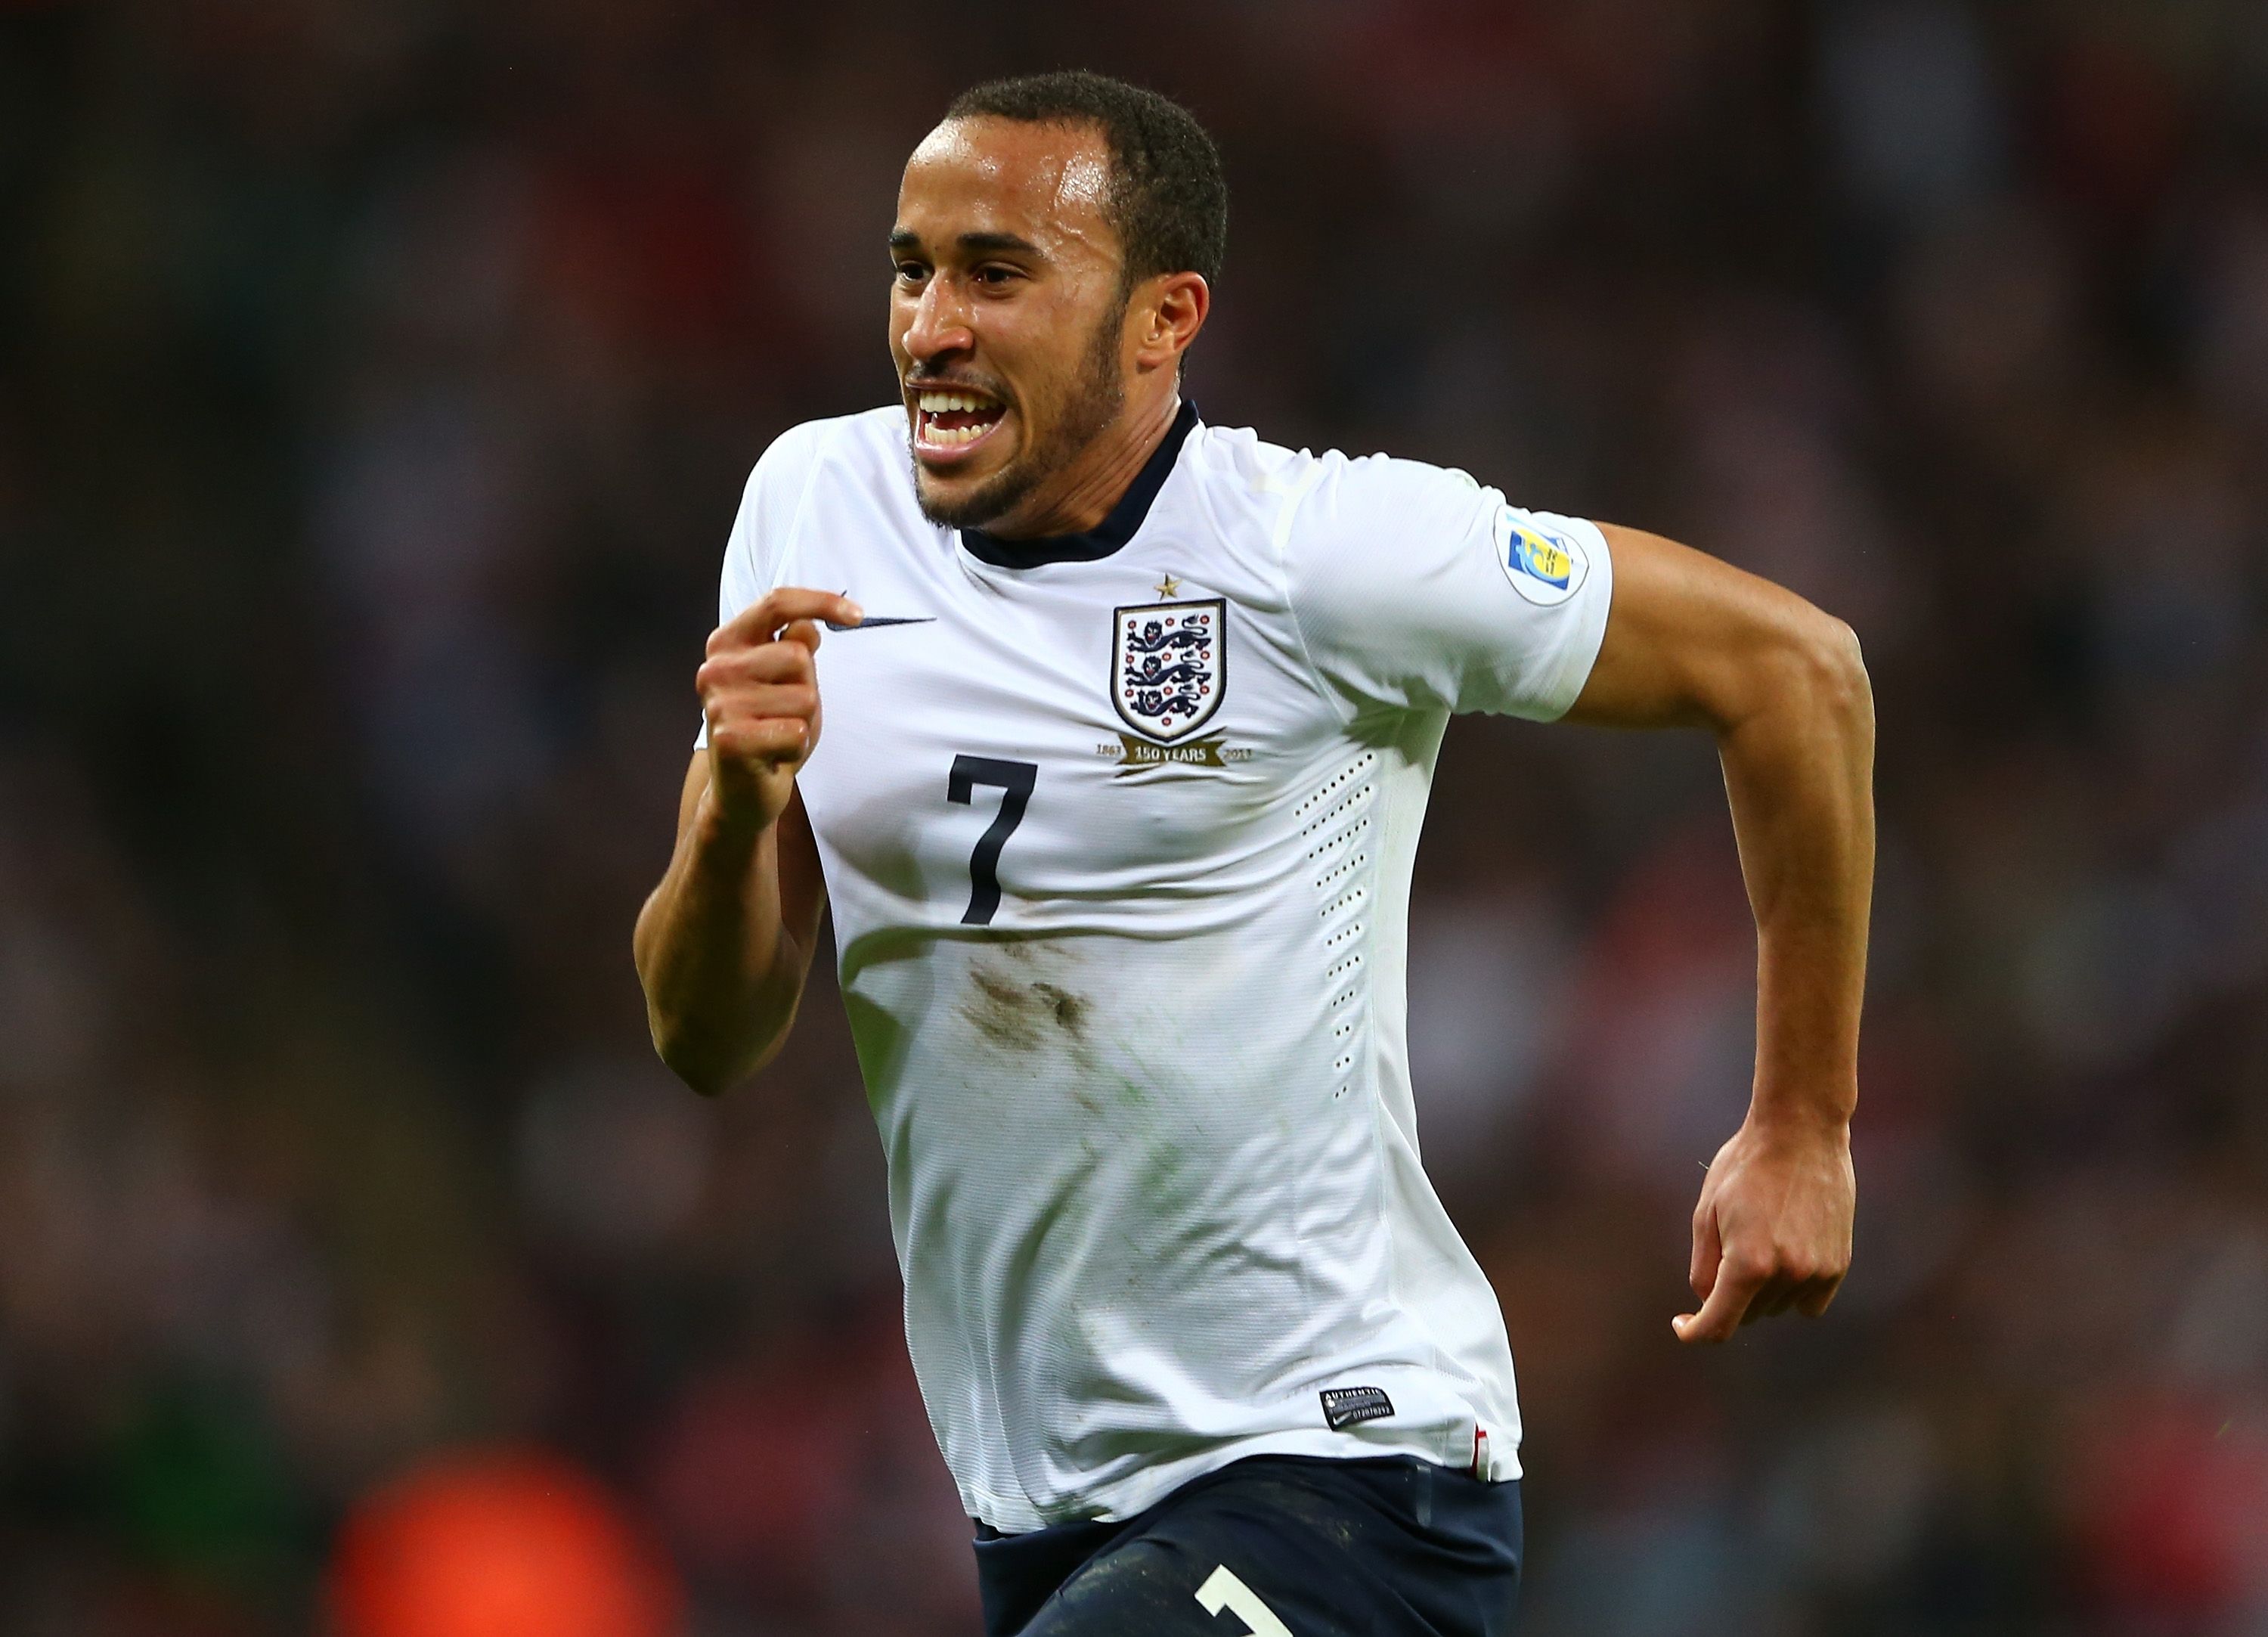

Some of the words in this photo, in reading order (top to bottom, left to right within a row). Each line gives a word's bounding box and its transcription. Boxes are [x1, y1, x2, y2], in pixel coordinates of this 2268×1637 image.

[1136, 745, 1160, 761] 150
[1163, 746, 1207, 763] YEARS
[947, 754, 1039, 925] 7
